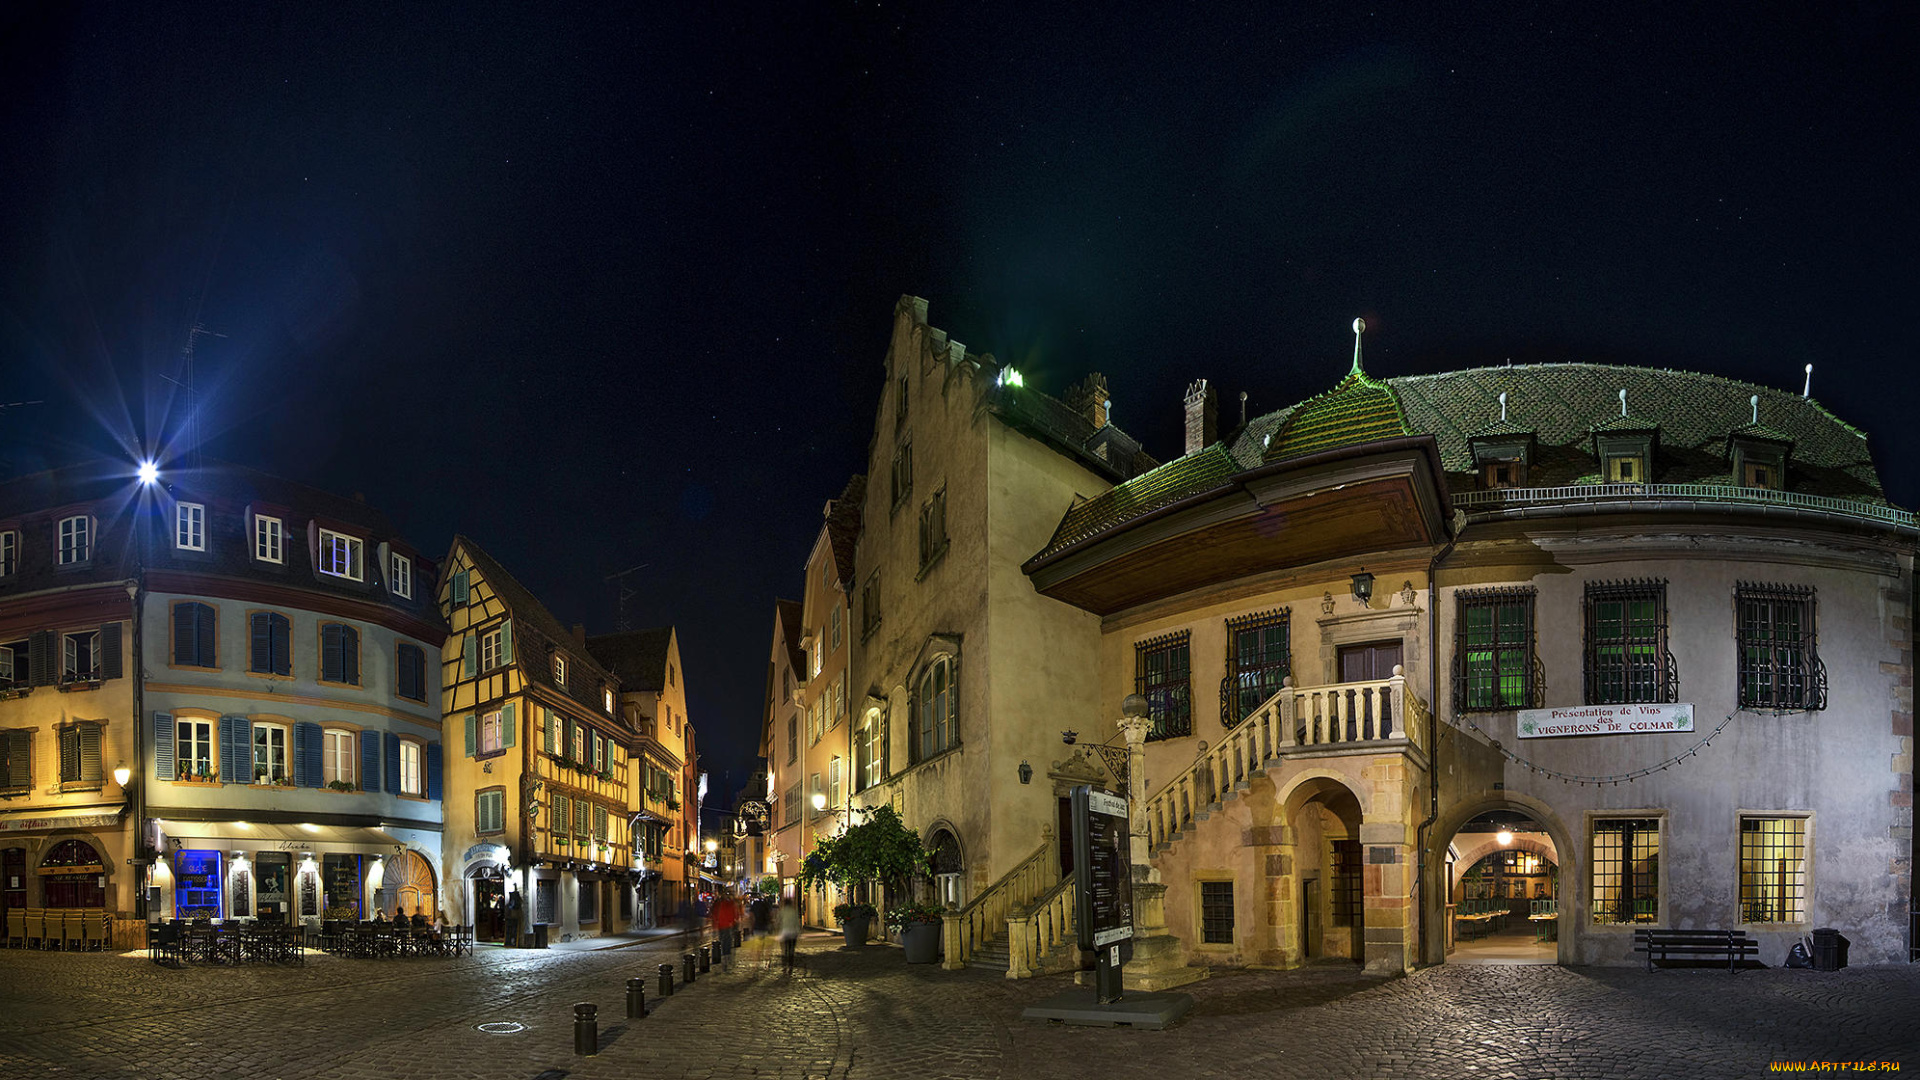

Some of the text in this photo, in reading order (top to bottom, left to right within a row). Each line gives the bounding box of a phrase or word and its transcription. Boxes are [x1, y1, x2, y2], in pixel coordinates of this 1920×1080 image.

[1551, 706, 1661, 719] Présentation de Vins
[1597, 716, 1613, 724] des
[1538, 721, 1674, 735] VIGNERONS DE COLMAR
